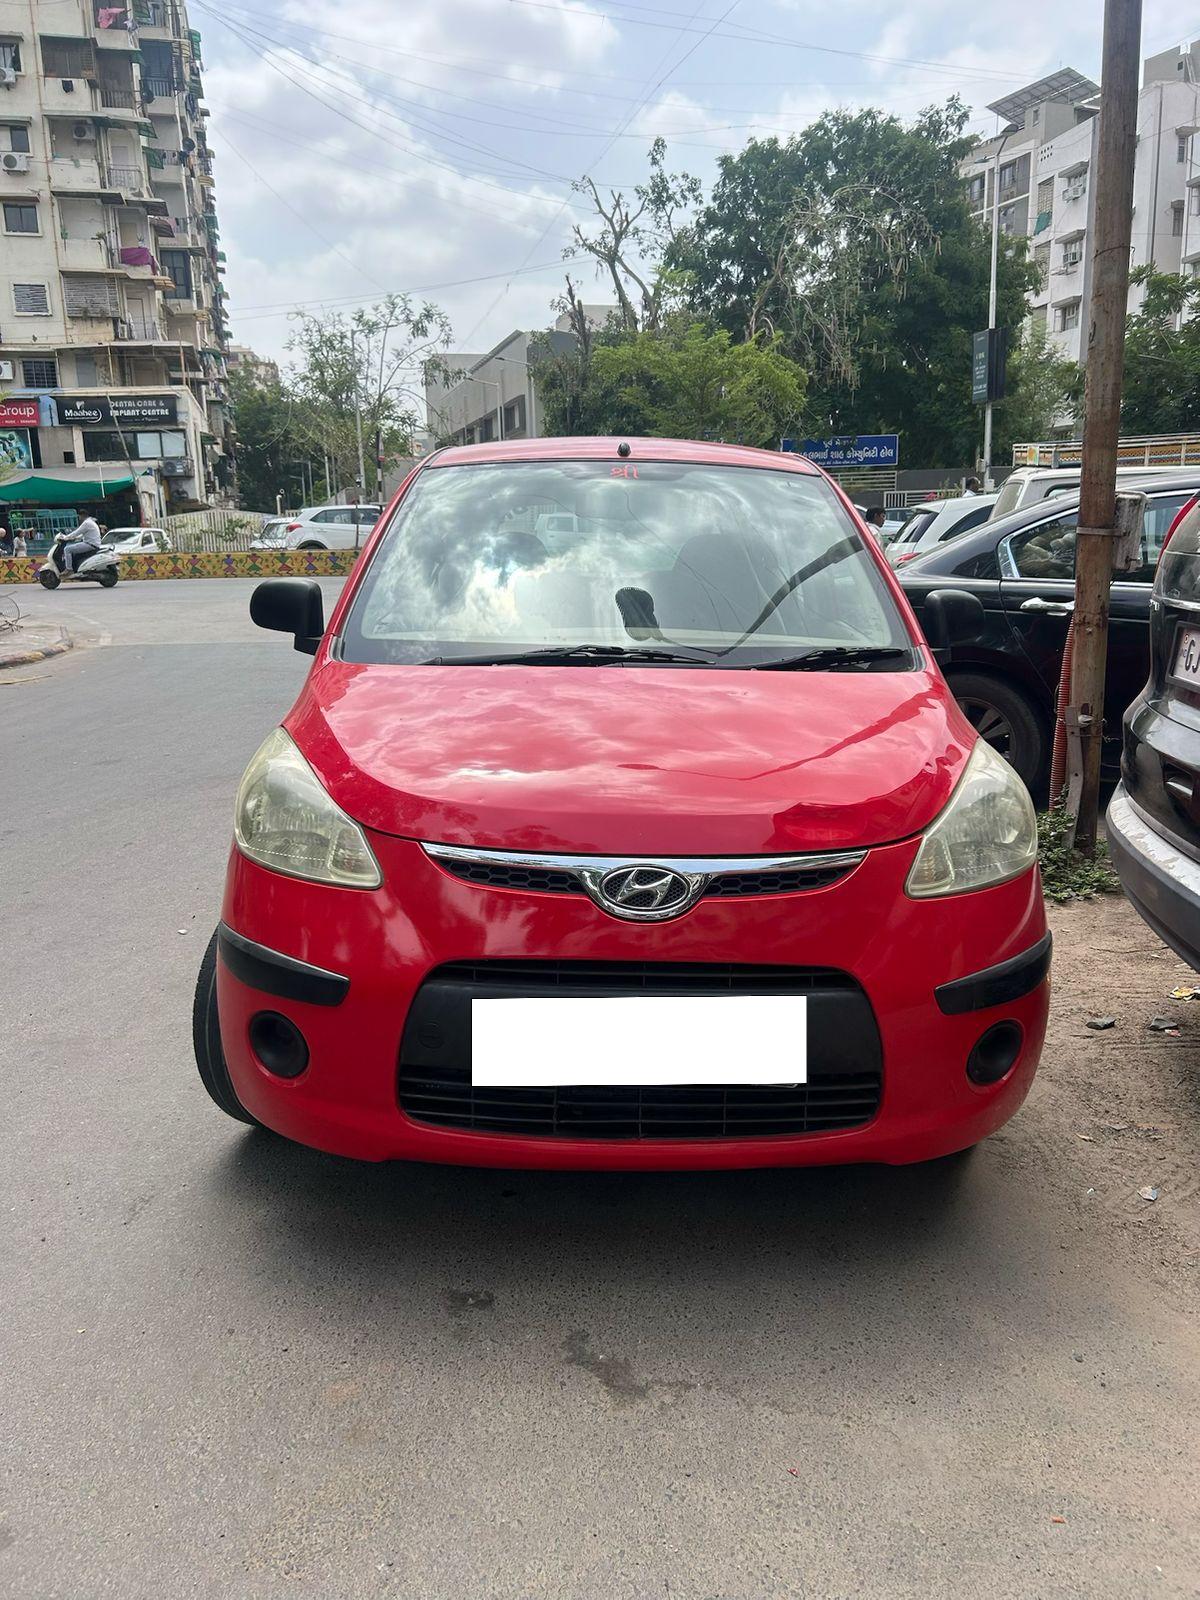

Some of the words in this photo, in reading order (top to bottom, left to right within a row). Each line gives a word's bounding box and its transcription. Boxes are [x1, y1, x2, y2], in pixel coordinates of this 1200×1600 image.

[0, 404, 34, 417] Group
[64, 409, 98, 417] Maahee
[141, 408, 169, 416] CENTRE
